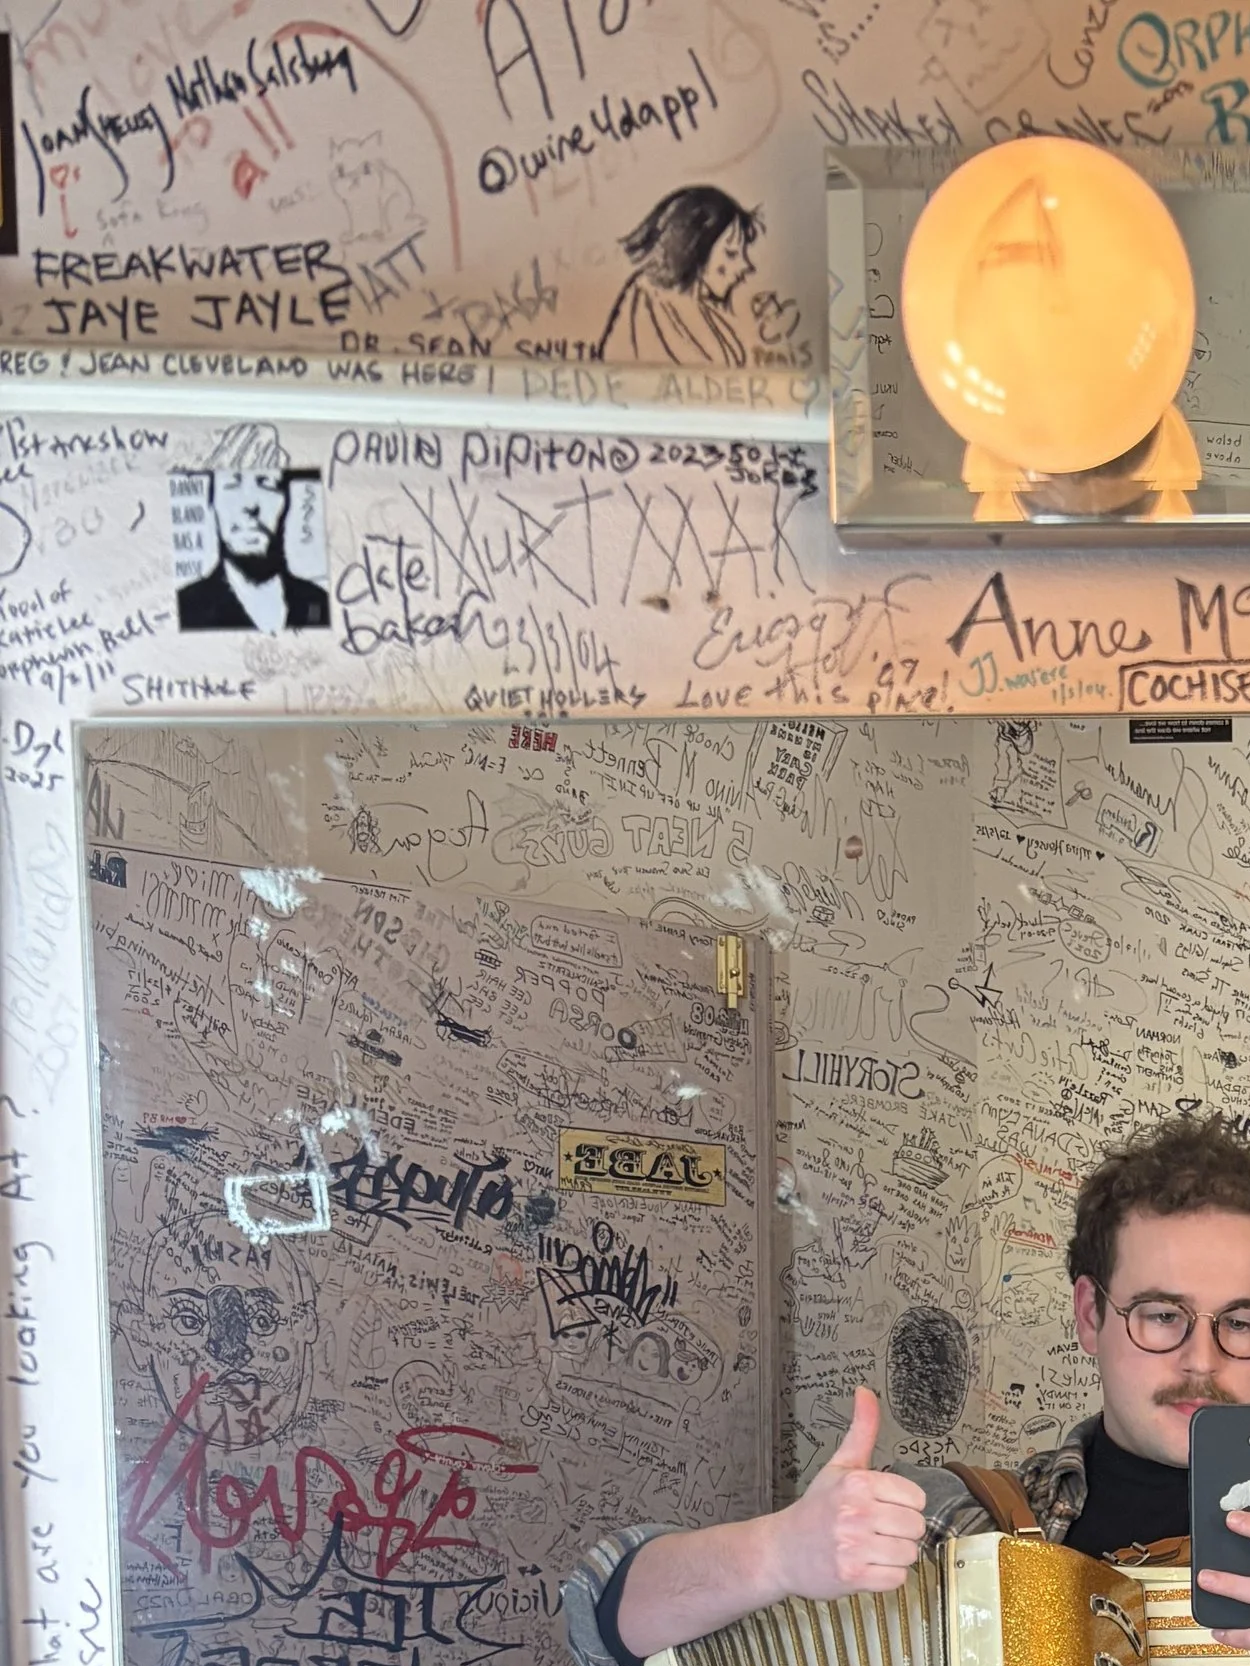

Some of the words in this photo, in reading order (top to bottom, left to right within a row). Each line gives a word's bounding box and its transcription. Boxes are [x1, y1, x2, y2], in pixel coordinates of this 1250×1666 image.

[33, 239, 350, 290] FREAKWATER
[44, 296, 158, 340] JAYE
[79, 353, 150, 377] JEAN
[163, 352, 308, 378] CLEVELAND
[327, 360, 383, 383] WAS
[946, 570, 1153, 664] Anne
[465, 684, 533, 713] QUIET
[677, 681, 752, 710] LOVE
[4, 1240, 54, 1388] looking
